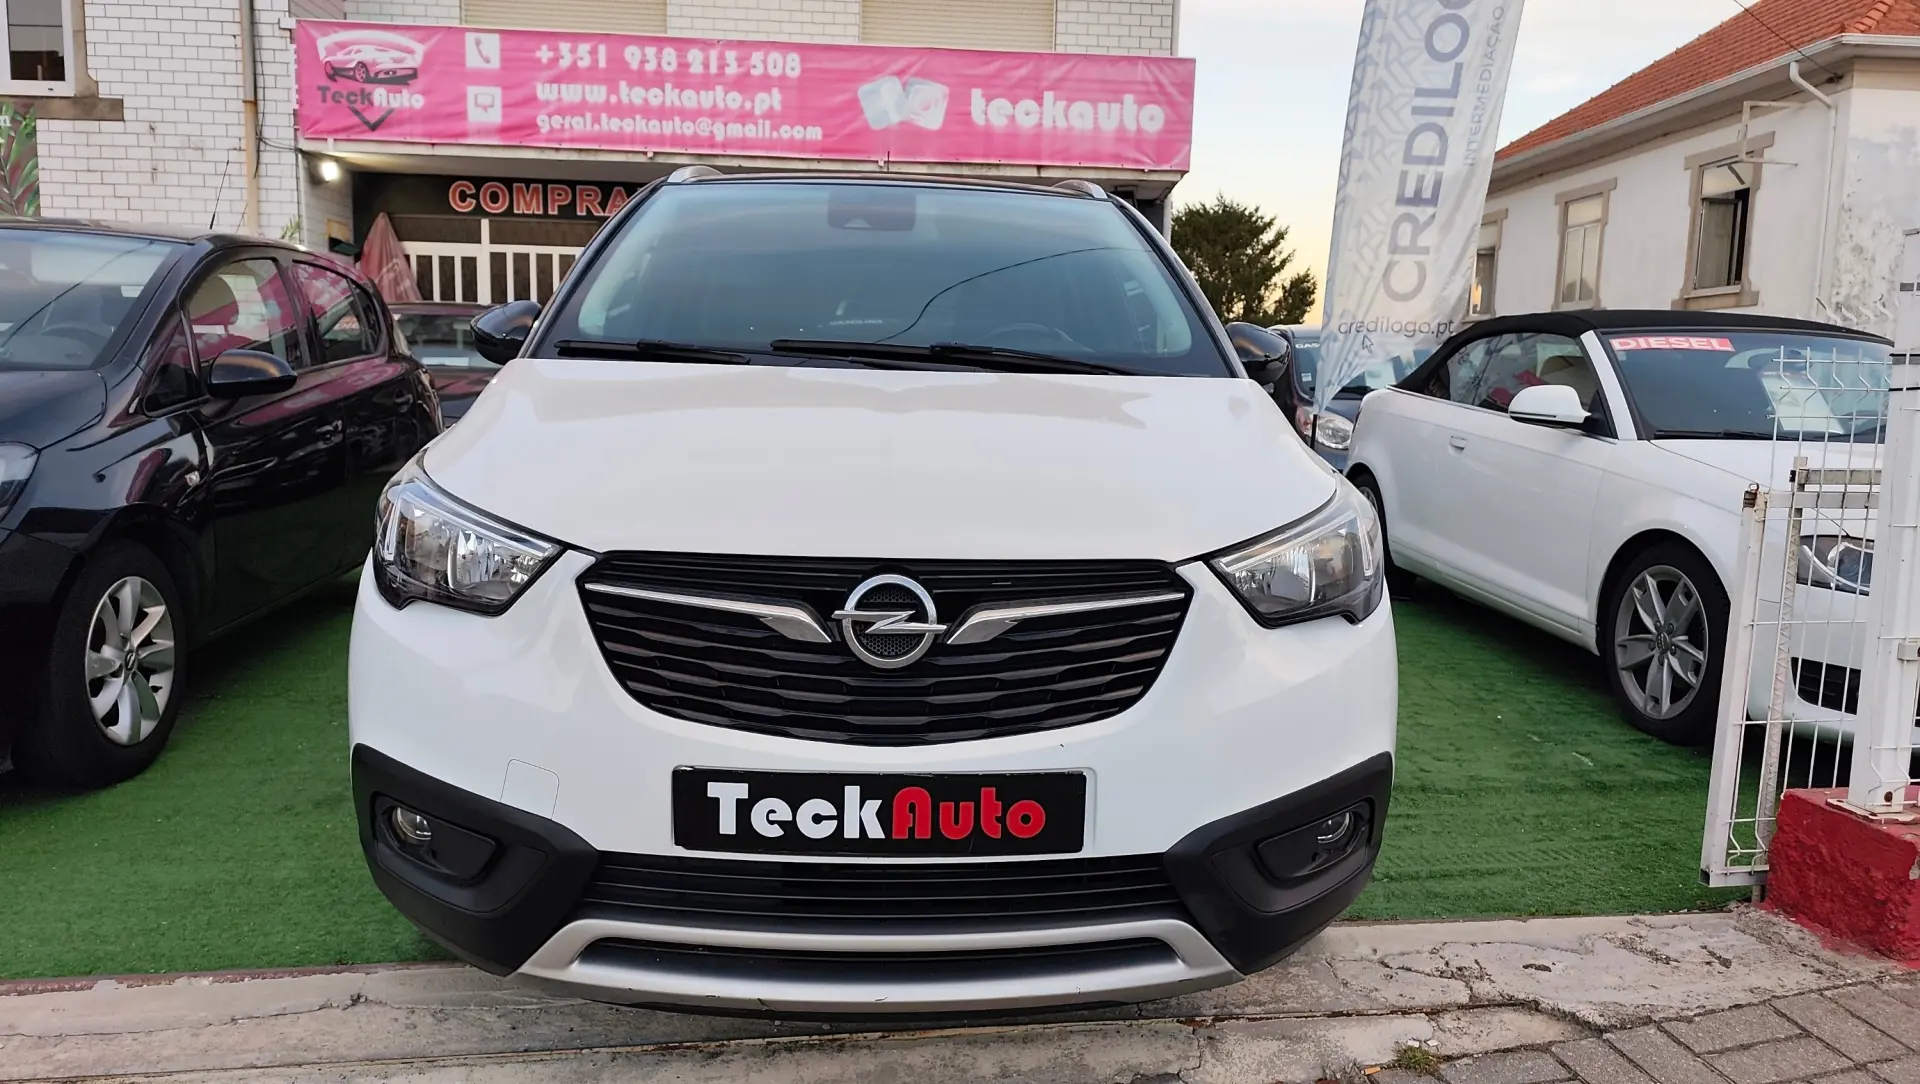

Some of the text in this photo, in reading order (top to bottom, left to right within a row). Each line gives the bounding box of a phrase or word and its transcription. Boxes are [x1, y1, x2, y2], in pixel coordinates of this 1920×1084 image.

[535, 43, 801, 78] +351 938 213 508
[317, 85, 425, 109] TeckAuto
[536, 80, 783, 115] www.teckauto.pt
[1463, 6, 1504, 167] INTERMEDIAÇÃO
[536, 112, 823, 141] geral.teckauto@gmail.com
[970, 88, 1165, 132] teckauto
[448, 180, 641, 218] COMPRA
[1338, 316, 1454, 338] credilogo.pt
[1612, 337, 1732, 350] DIESEL
[707, 781, 1046, 839] TeckAuto
